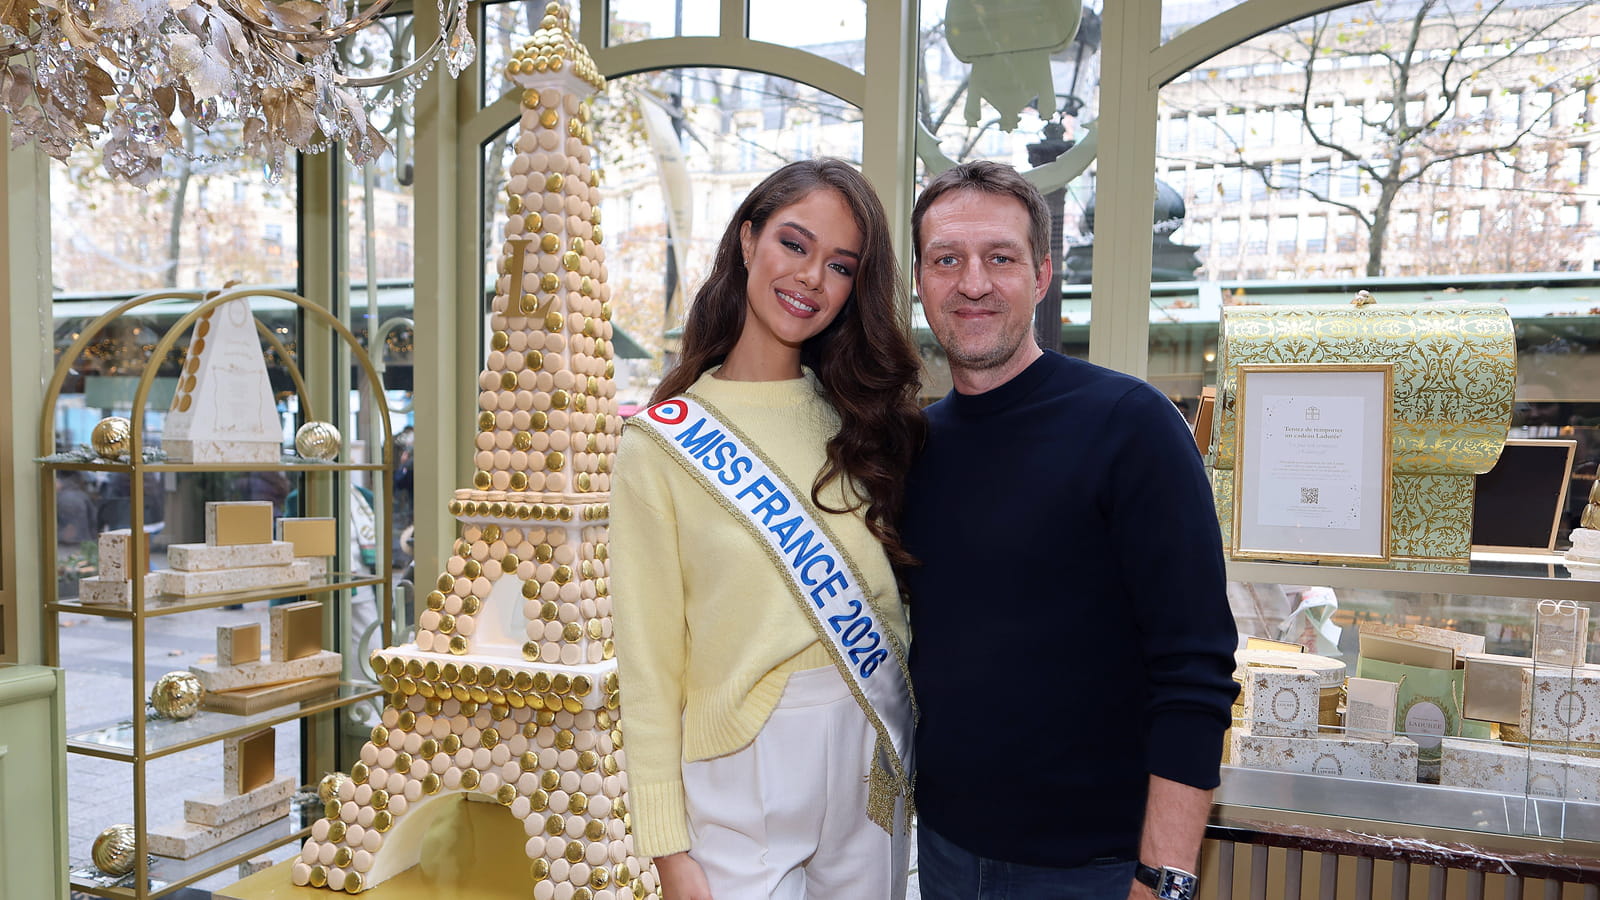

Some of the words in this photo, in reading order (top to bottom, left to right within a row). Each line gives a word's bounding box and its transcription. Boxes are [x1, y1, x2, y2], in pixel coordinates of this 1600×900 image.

[498, 240, 555, 318] L
[675, 418, 753, 486] MISS
[736, 475, 849, 609] FRANCE
[828, 600, 888, 679] 2026
